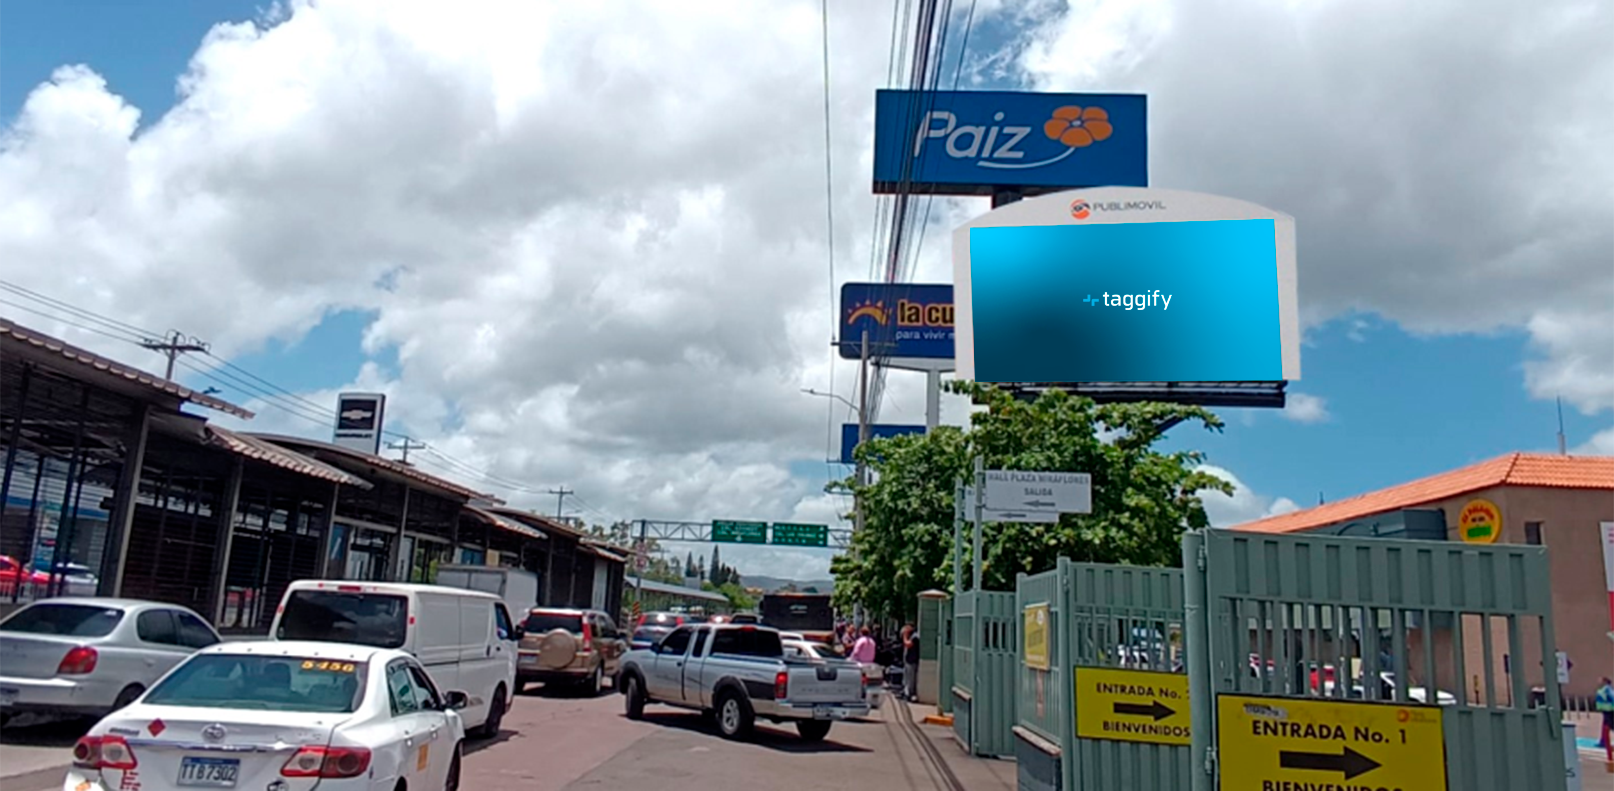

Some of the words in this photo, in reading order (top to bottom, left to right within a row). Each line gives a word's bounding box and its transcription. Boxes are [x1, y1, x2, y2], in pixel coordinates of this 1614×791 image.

[914, 111, 1031, 158] Paiz
[1093, 200, 1166, 211] PUBLIMOVIL
[1102, 289, 1172, 310] taggify
[898, 299, 922, 326] la
[896, 331, 920, 341] para
[923, 330, 945, 339] vivir
[1024, 487, 1053, 496] SALIDA
[1096, 682, 1155, 697] ENTRADA
[1159, 687, 1181, 699] No.
[1103, 720, 1190, 737] BIENVENIDOS
[1252, 719, 1346, 740] ENTRADA
[1353, 726, 1390, 743] No.
[1398, 729, 1406, 744] 1
